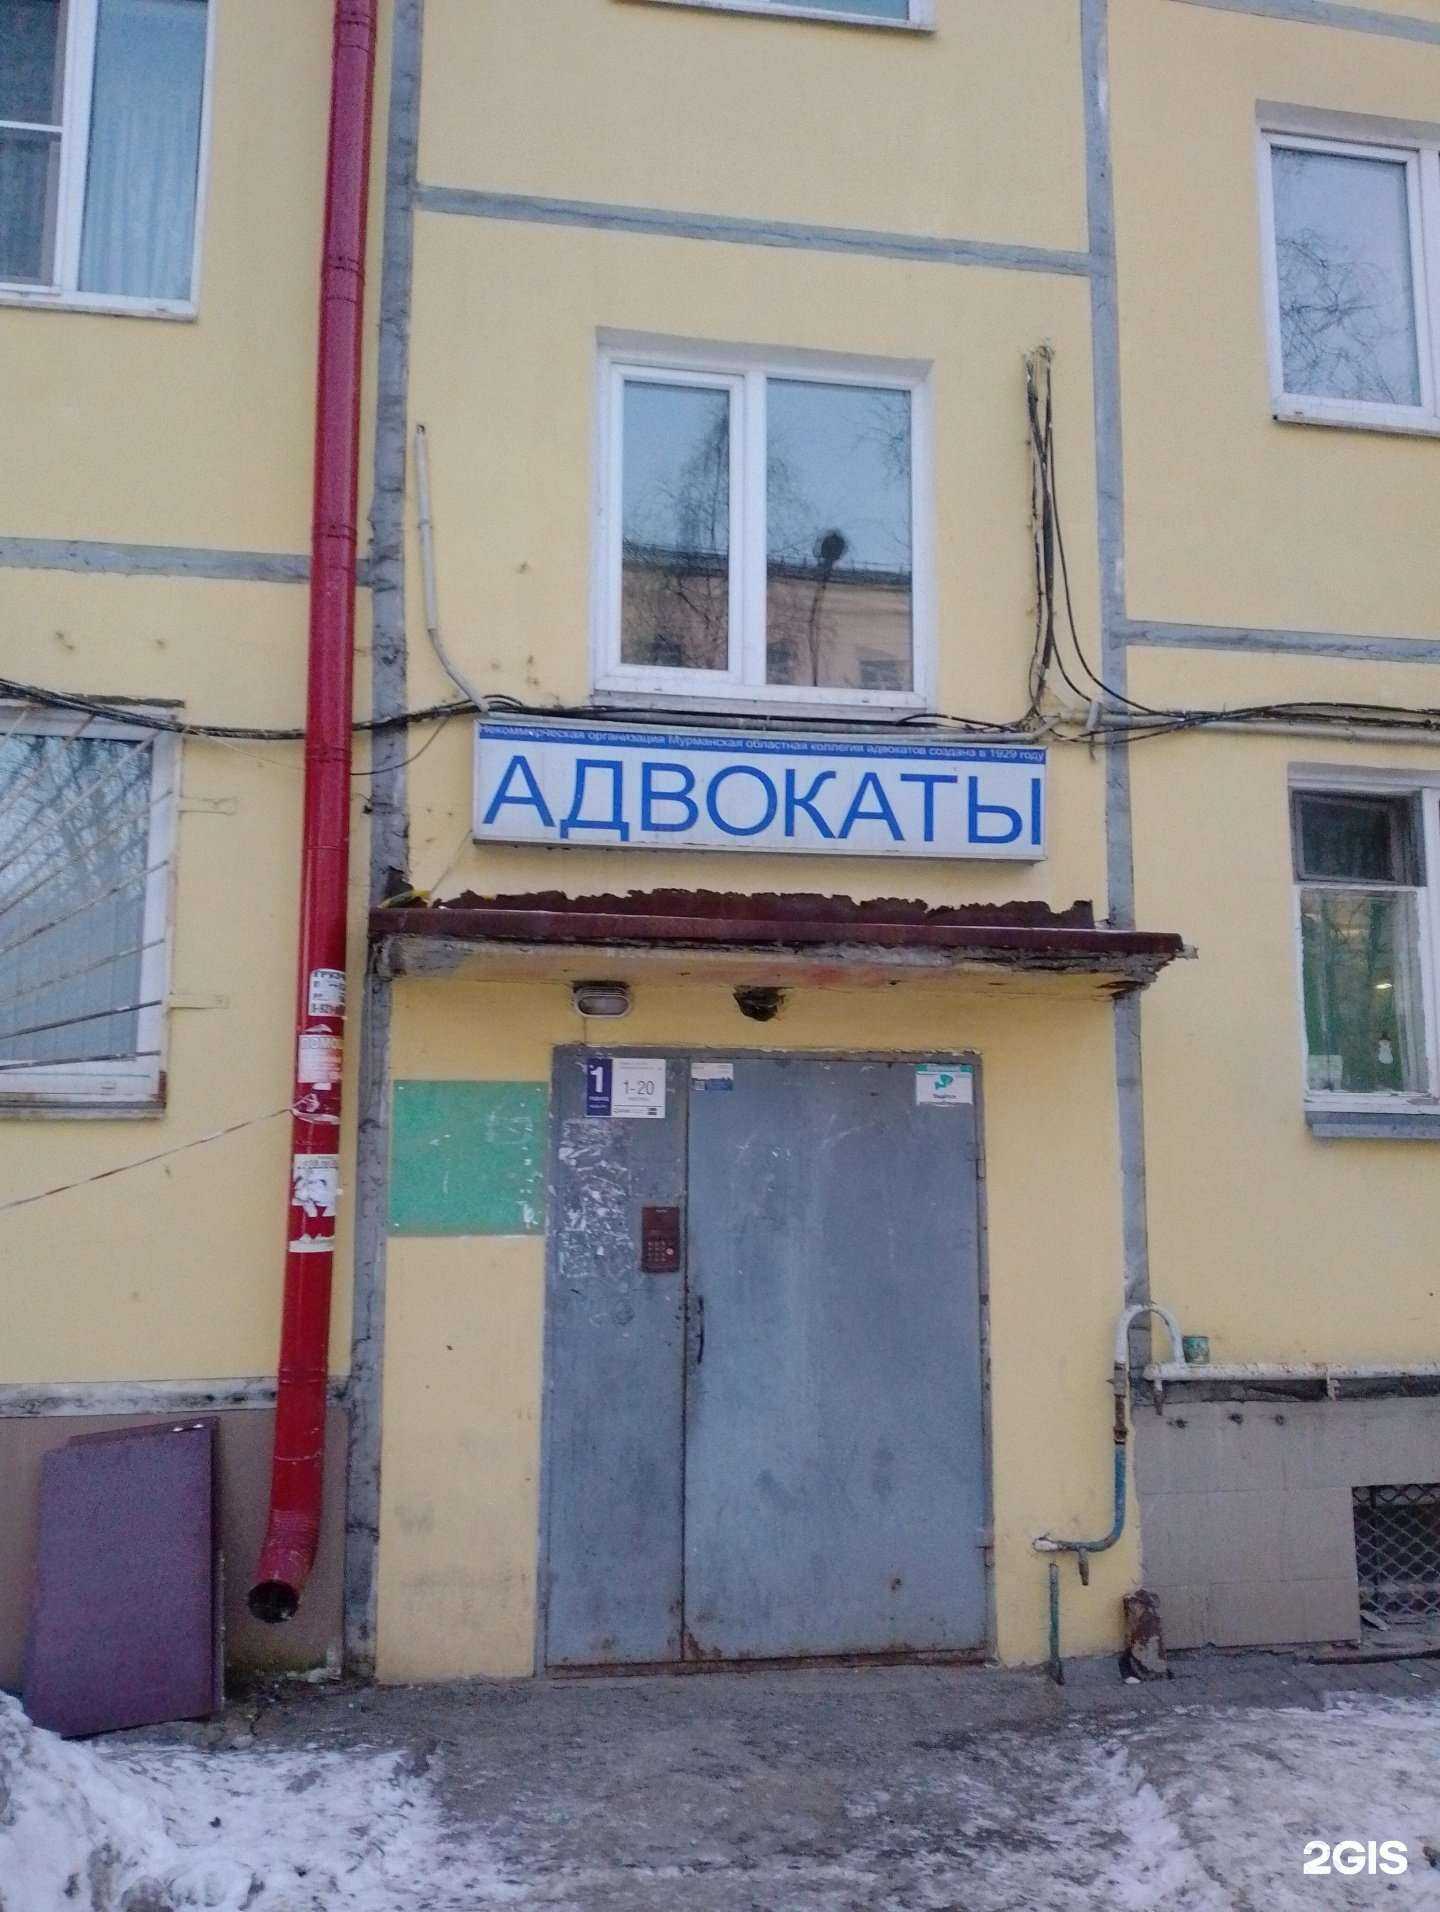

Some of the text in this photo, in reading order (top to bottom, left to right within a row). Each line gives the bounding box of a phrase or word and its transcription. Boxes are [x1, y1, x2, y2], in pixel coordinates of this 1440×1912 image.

[990, 749, 1017, 760] 1929
[481, 755, 1041, 845] АДВОКАТЫ
[590, 1066, 604, 1093] 1
